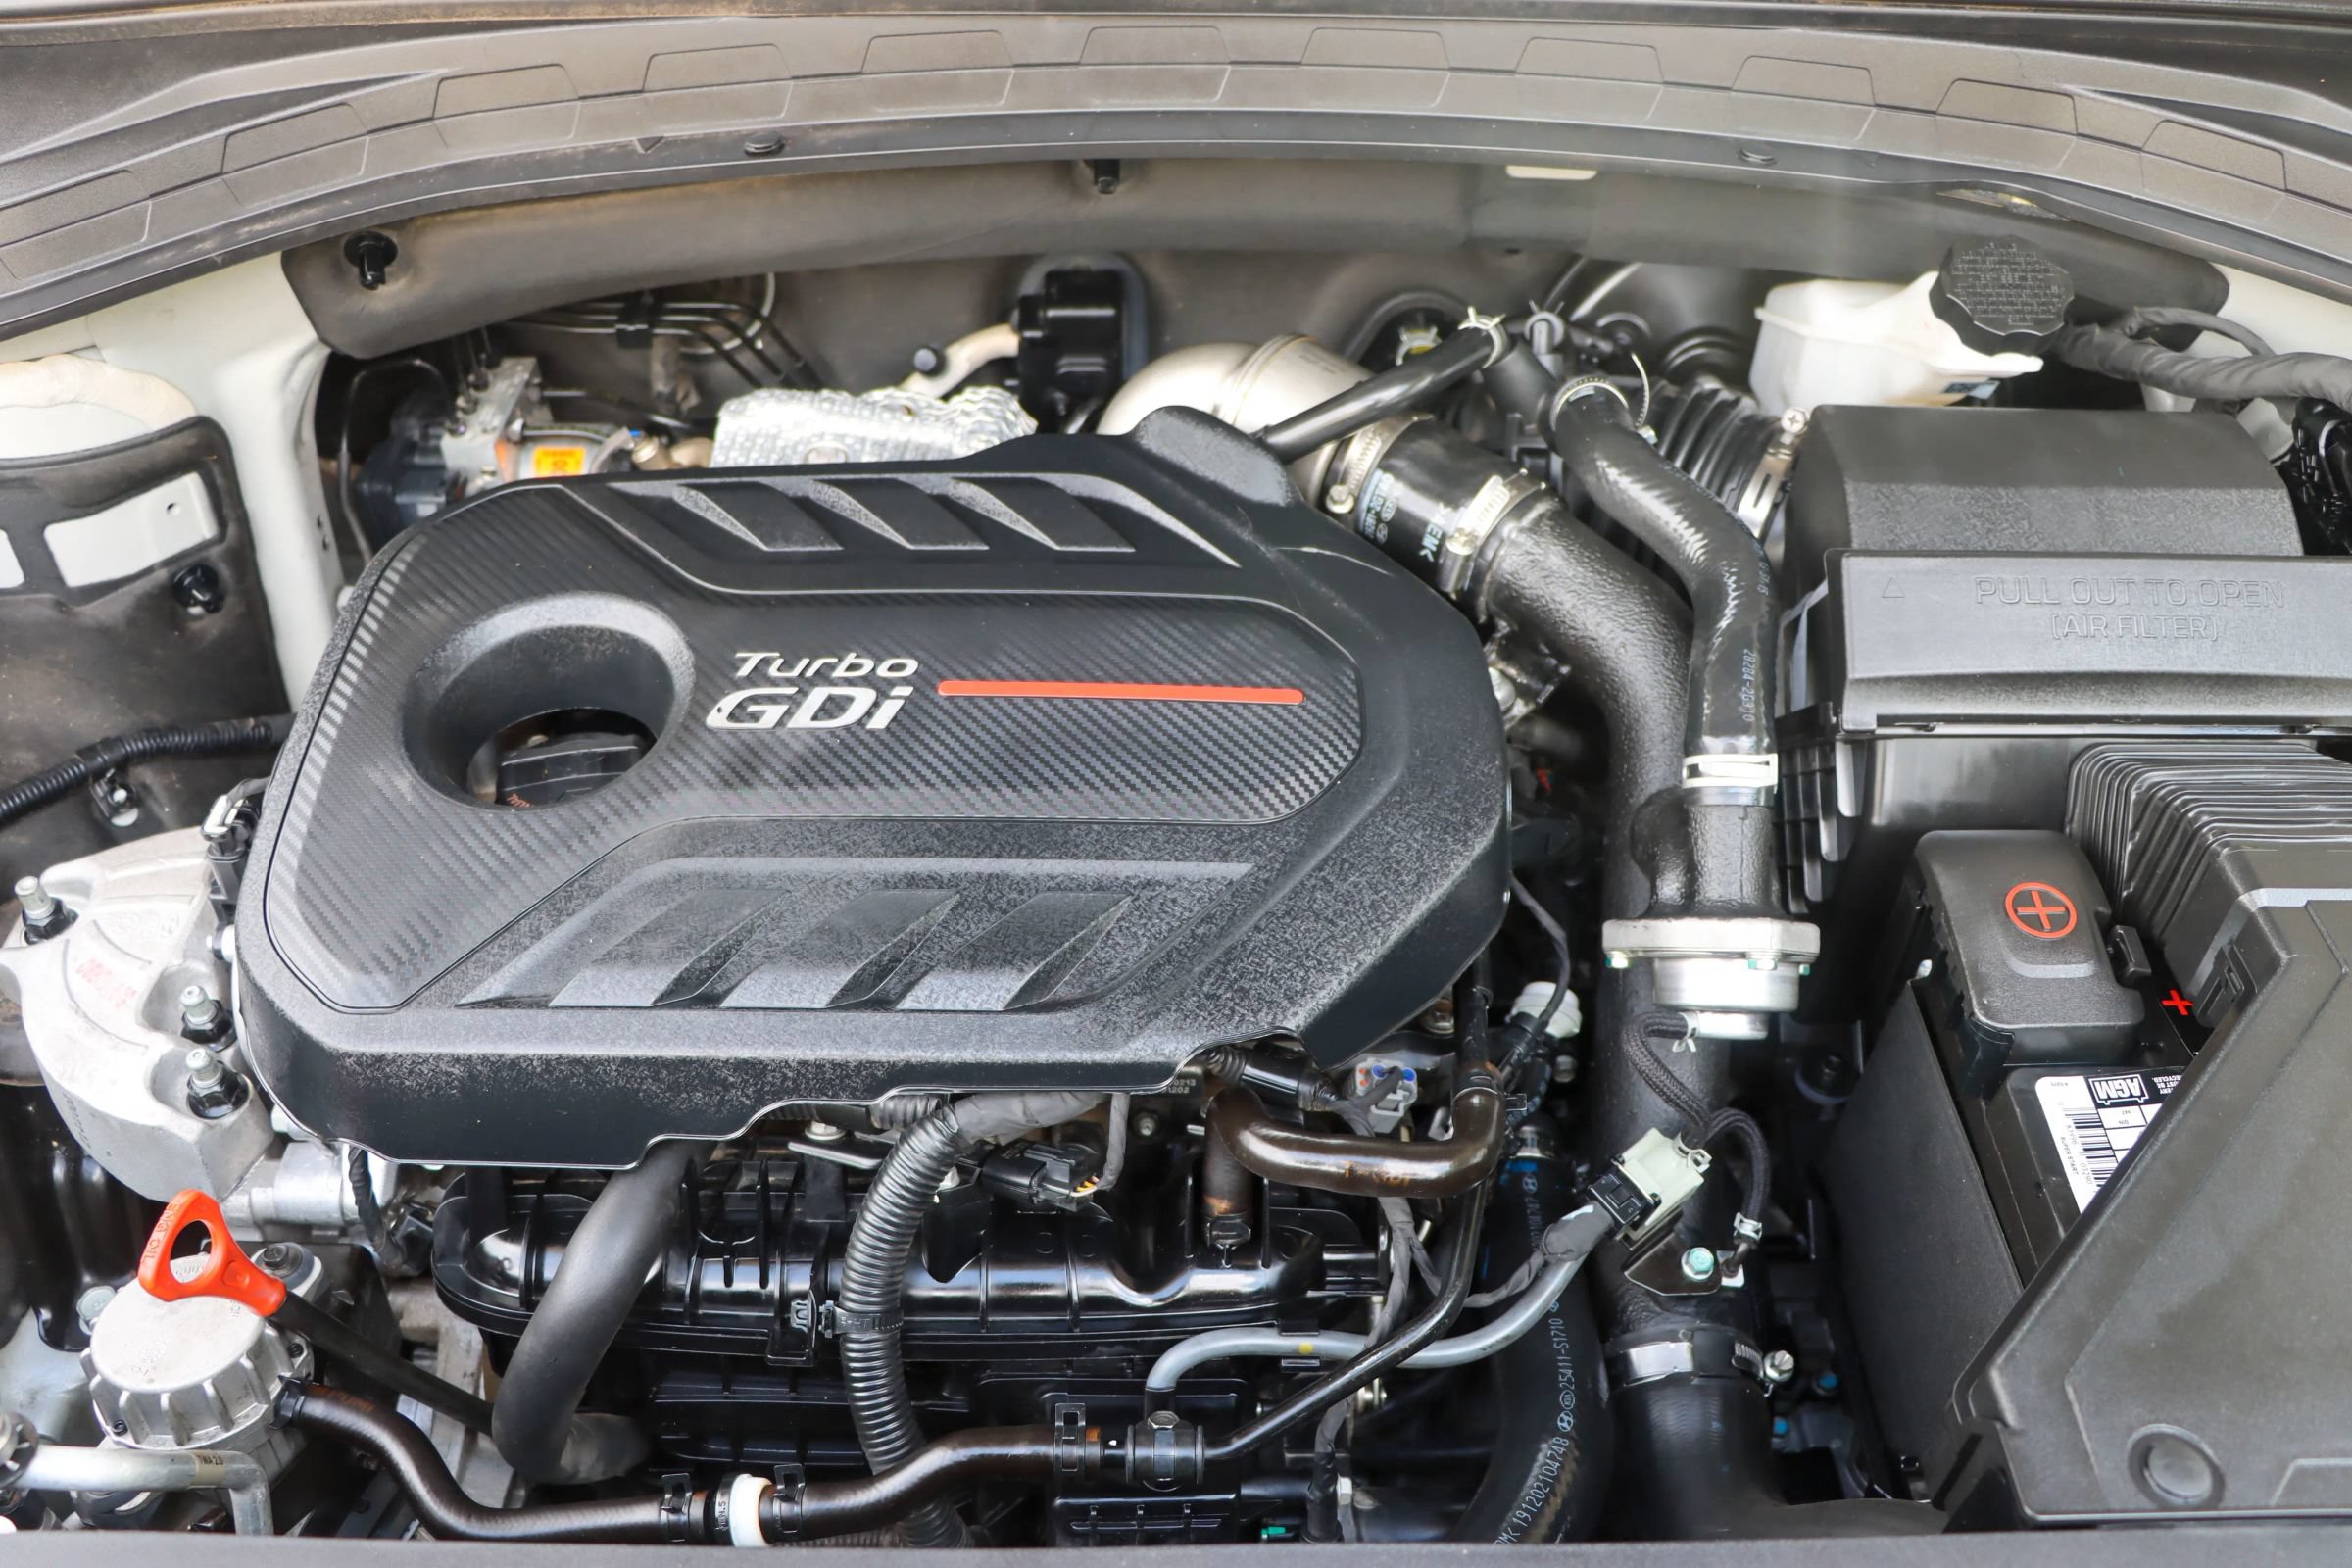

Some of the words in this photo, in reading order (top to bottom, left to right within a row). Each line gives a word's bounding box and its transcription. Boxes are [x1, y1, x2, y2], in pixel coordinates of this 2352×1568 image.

[1975, 577, 2061, 604] PULL
[2070, 578, 2135, 605] OUT
[2145, 579, 2187, 605] TO
[2198, 580, 2284, 608] OPEN
[2052, 614, 2108, 640] (AIR
[2118, 615, 2218, 642] FILTER)
[736, 652, 919, 677] Turbo
[706, 686, 914, 729] GDi
[2094, 1078, 2142, 1100] AGM
[1548, 1318, 1575, 1390] 25411-S1710
[1512, 1437, 1569, 1527] 191202104748
